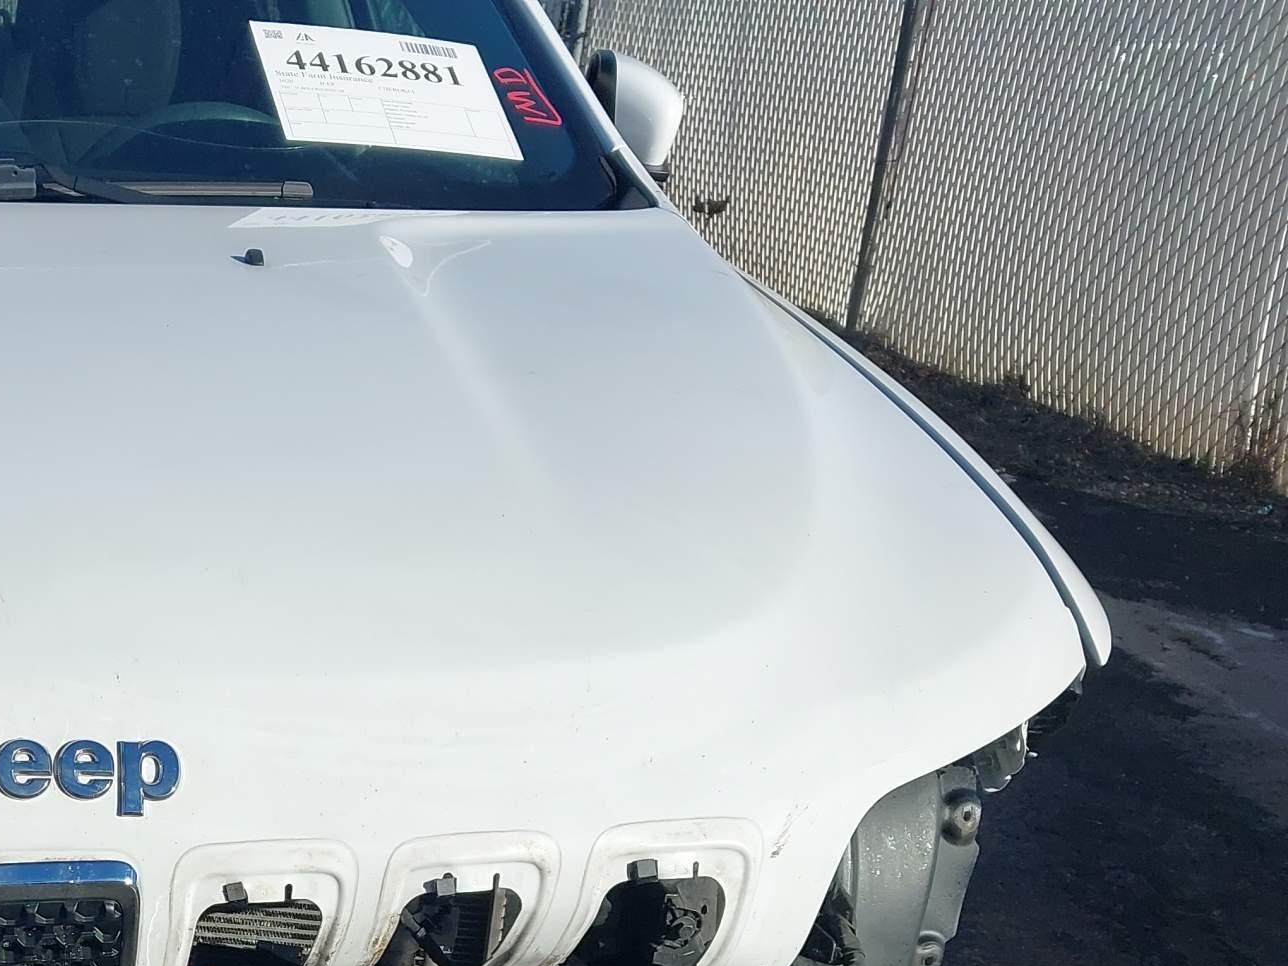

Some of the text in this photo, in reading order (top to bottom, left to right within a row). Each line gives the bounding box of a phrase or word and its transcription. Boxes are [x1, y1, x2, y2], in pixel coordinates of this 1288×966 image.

[274, 69, 374, 84] State Farm Insurance
[286, 49, 464, 87] 44162881
